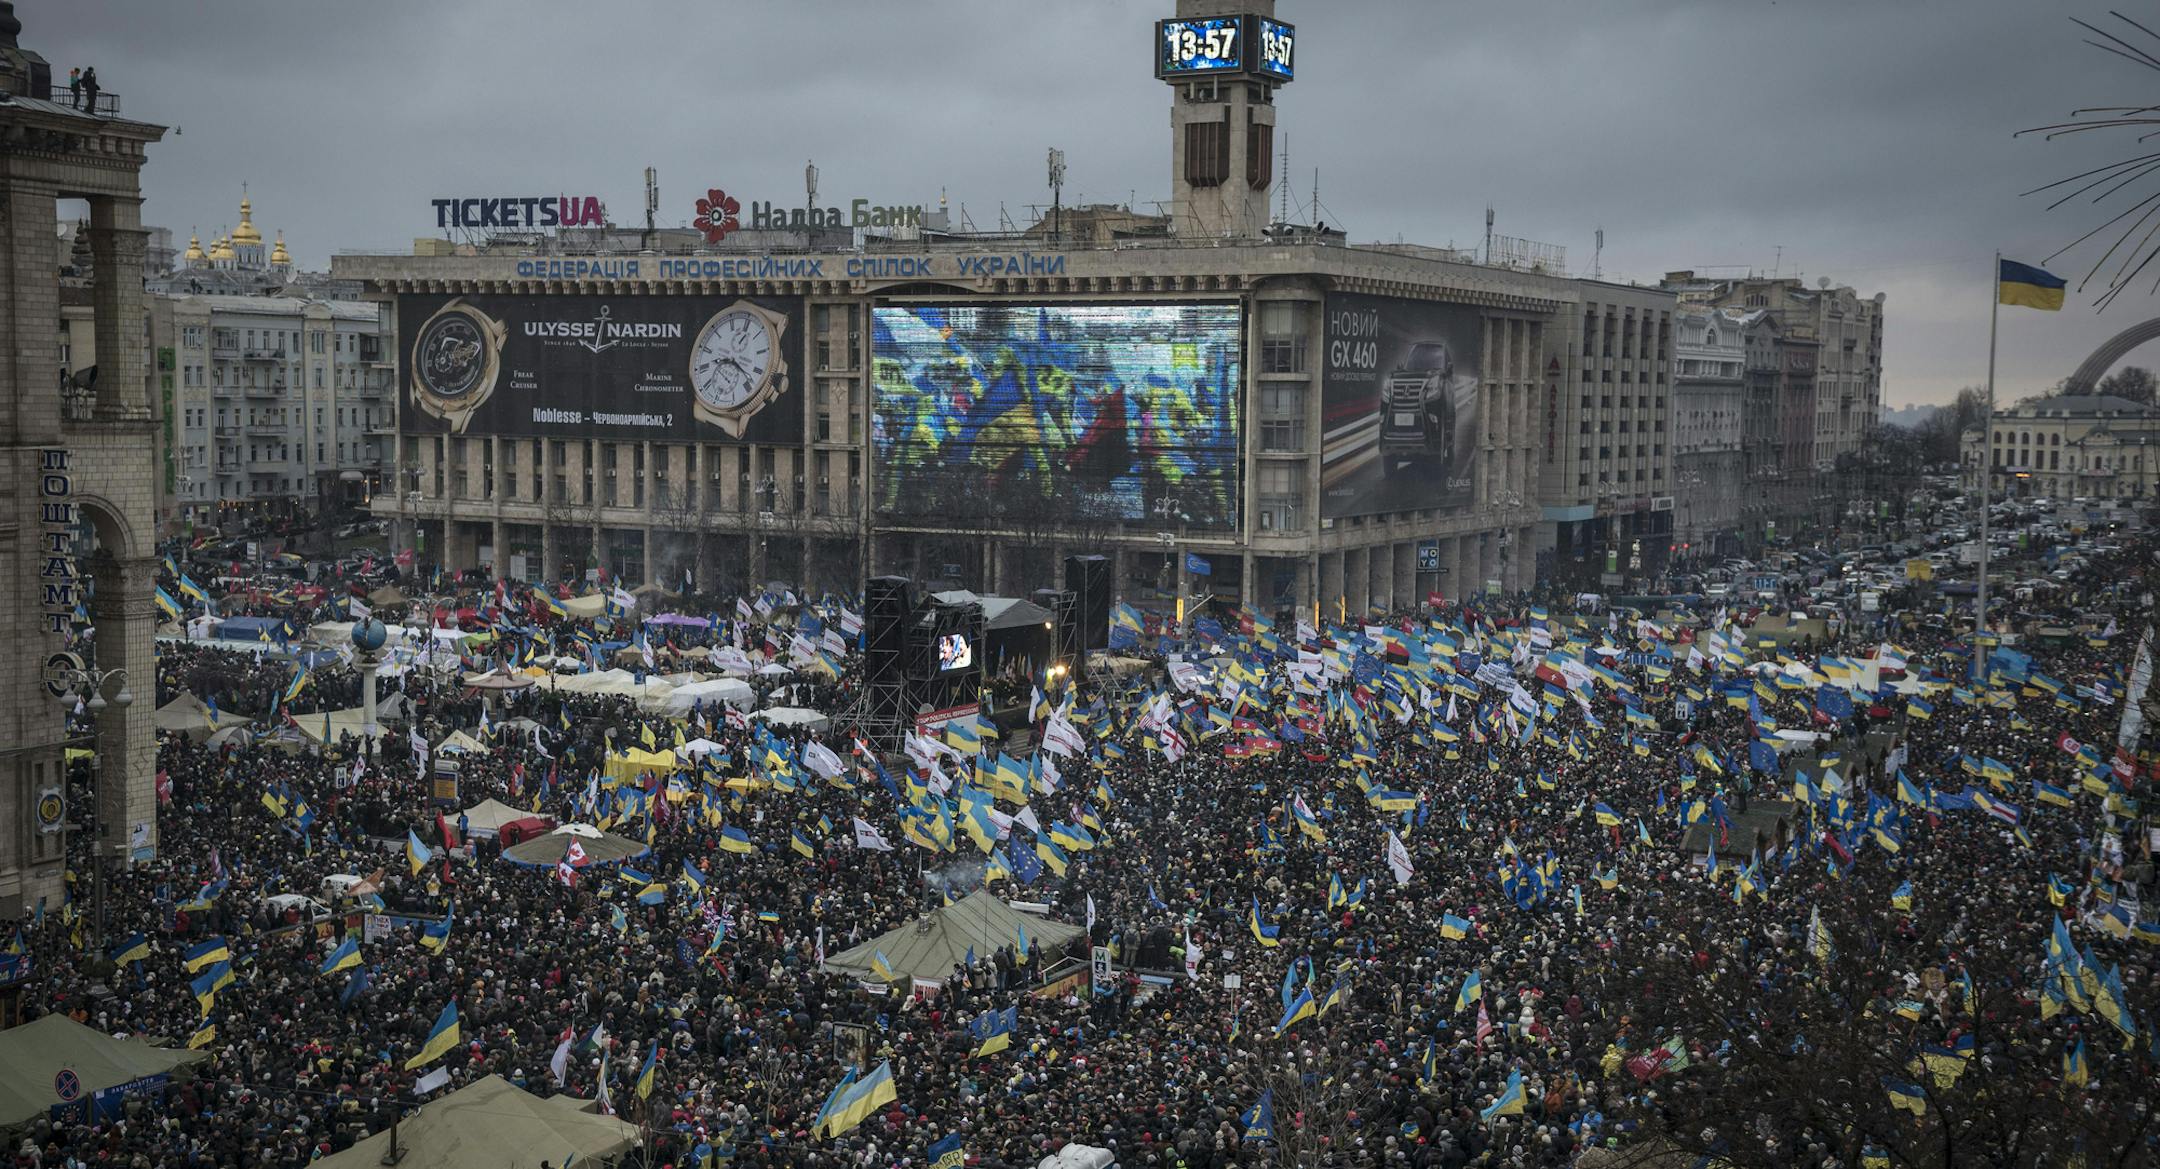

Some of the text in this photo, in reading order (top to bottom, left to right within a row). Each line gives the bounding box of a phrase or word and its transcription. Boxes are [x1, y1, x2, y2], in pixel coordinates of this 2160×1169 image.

[1168, 28, 1236, 61] 13:57
[1262, 31, 1292, 66] 13:57
[752, 199, 921, 233] Надра Банк
[517, 252, 1065, 279] ФЕДЕРАЦІЯ ПРОФЕСІЙНИХ СПІЛОК УКРАЇНИ
[524, 322, 682, 338] ULYSSE NARDIN
[1331, 308, 1378, 338] НОВИЙ
[1331, 340, 1377, 369] GX 460
[533, 408, 582, 424] Noblesse
[667, 414, 672, 426] 2
[42, 450, 73, 632] ПОШТАМТ
